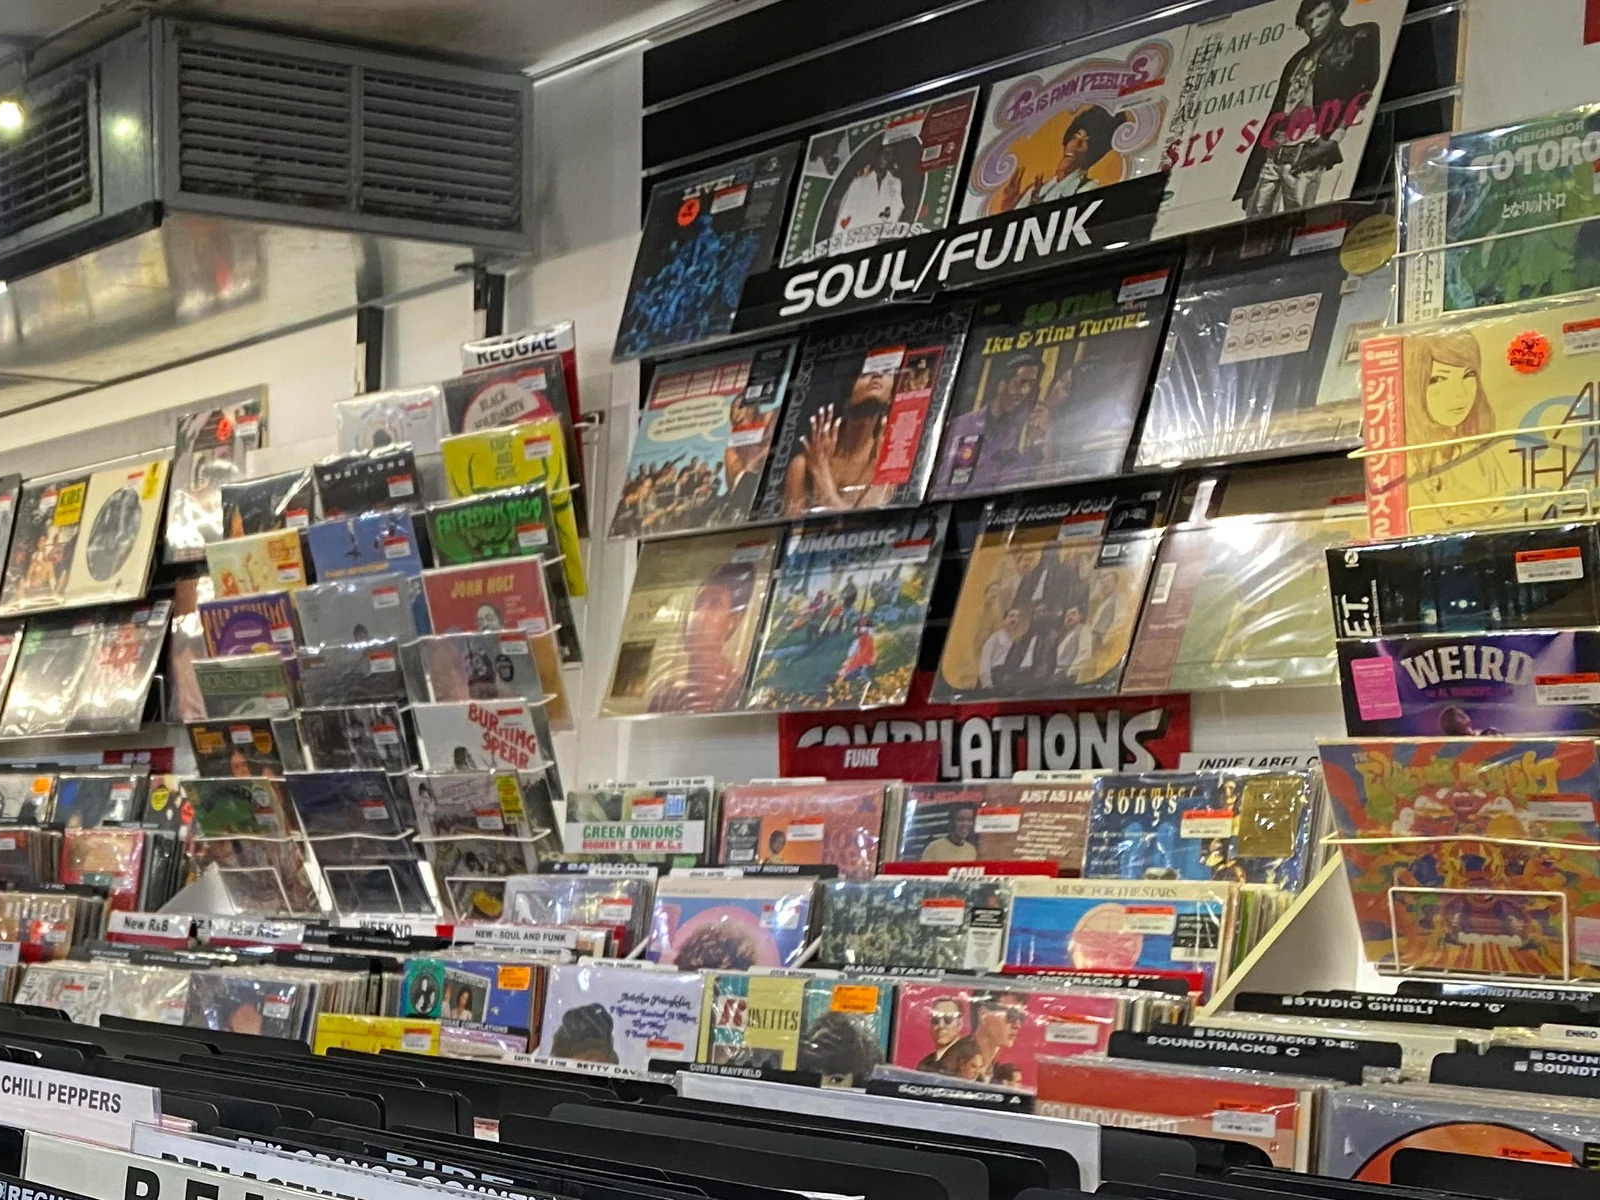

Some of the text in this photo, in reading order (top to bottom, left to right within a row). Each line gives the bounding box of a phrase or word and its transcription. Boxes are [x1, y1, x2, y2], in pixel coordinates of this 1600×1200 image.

[1512, 120, 1584, 145] NEIGHBOR
[779, 199, 1104, 317] SOUL/FUNK
[477, 336, 558, 365] REGGAE
[1401, 645, 1536, 690] WEIRD
[482, 733, 529, 768] SPEAR
[798, 708, 1163, 778] LATIONS
[844, 748, 880, 767] FUNK
[1104, 795, 1178, 827] songs
[582, 823, 684, 840] GREEN ONIONS
[123, 915, 146, 931] New
[475, 930, 492, 940] NEW
[500, 931, 520, 941] SOUL
[523, 932, 541, 941] AND
[543, 933, 566, 942] FUNK
[1463, 986, 1555, 1000] SOUNDTRACKS
[1295, 997, 1433, 1015] STUDIO GHIBLI
[1147, 1036, 1301, 1057] SOUNDTRACKS C
[1207, 1029, 1317, 1046] SOUNDTRACKS
[577, 1063, 608, 1073] BETTY
[689, 1063, 762, 1079] CURTIS MAYFIELD
[1, 1075, 42, 1100] CHILI
[48, 1083, 122, 1114] PEPPERS
